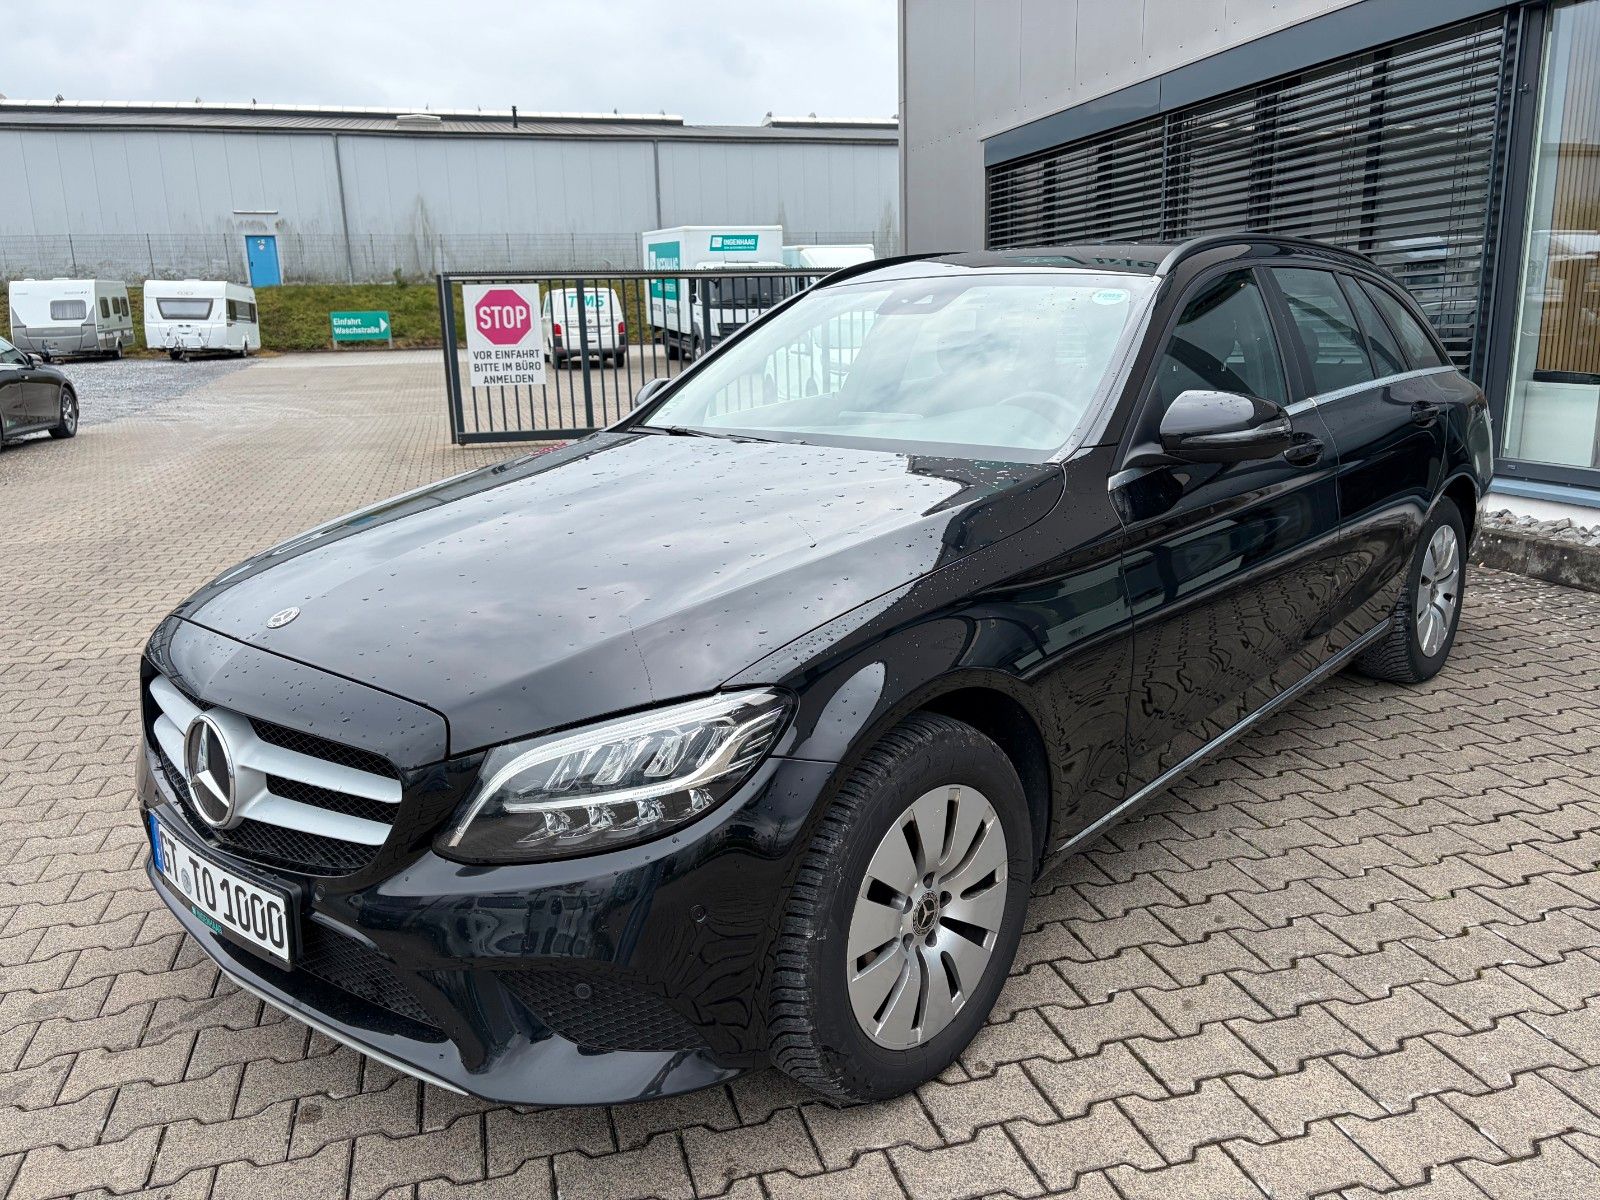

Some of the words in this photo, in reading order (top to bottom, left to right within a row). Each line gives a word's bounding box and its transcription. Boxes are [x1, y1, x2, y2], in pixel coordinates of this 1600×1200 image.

[333, 317, 361, 325] Einfahrt
[479, 305, 527, 329] STOP
[334, 326, 379, 334] Waschstraße
[473, 350, 493, 360] VOR
[495, 349, 540, 359] EINFAHRT
[474, 363, 501, 372] BITTE
[502, 363, 513, 371] IM
[515, 360, 541, 370] BÜRO
[483, 374, 534, 384] ANMELDEN
[160, 830, 179, 883] GT
[188, 855, 217, 912] TO
[220, 878, 285, 949] 1000
